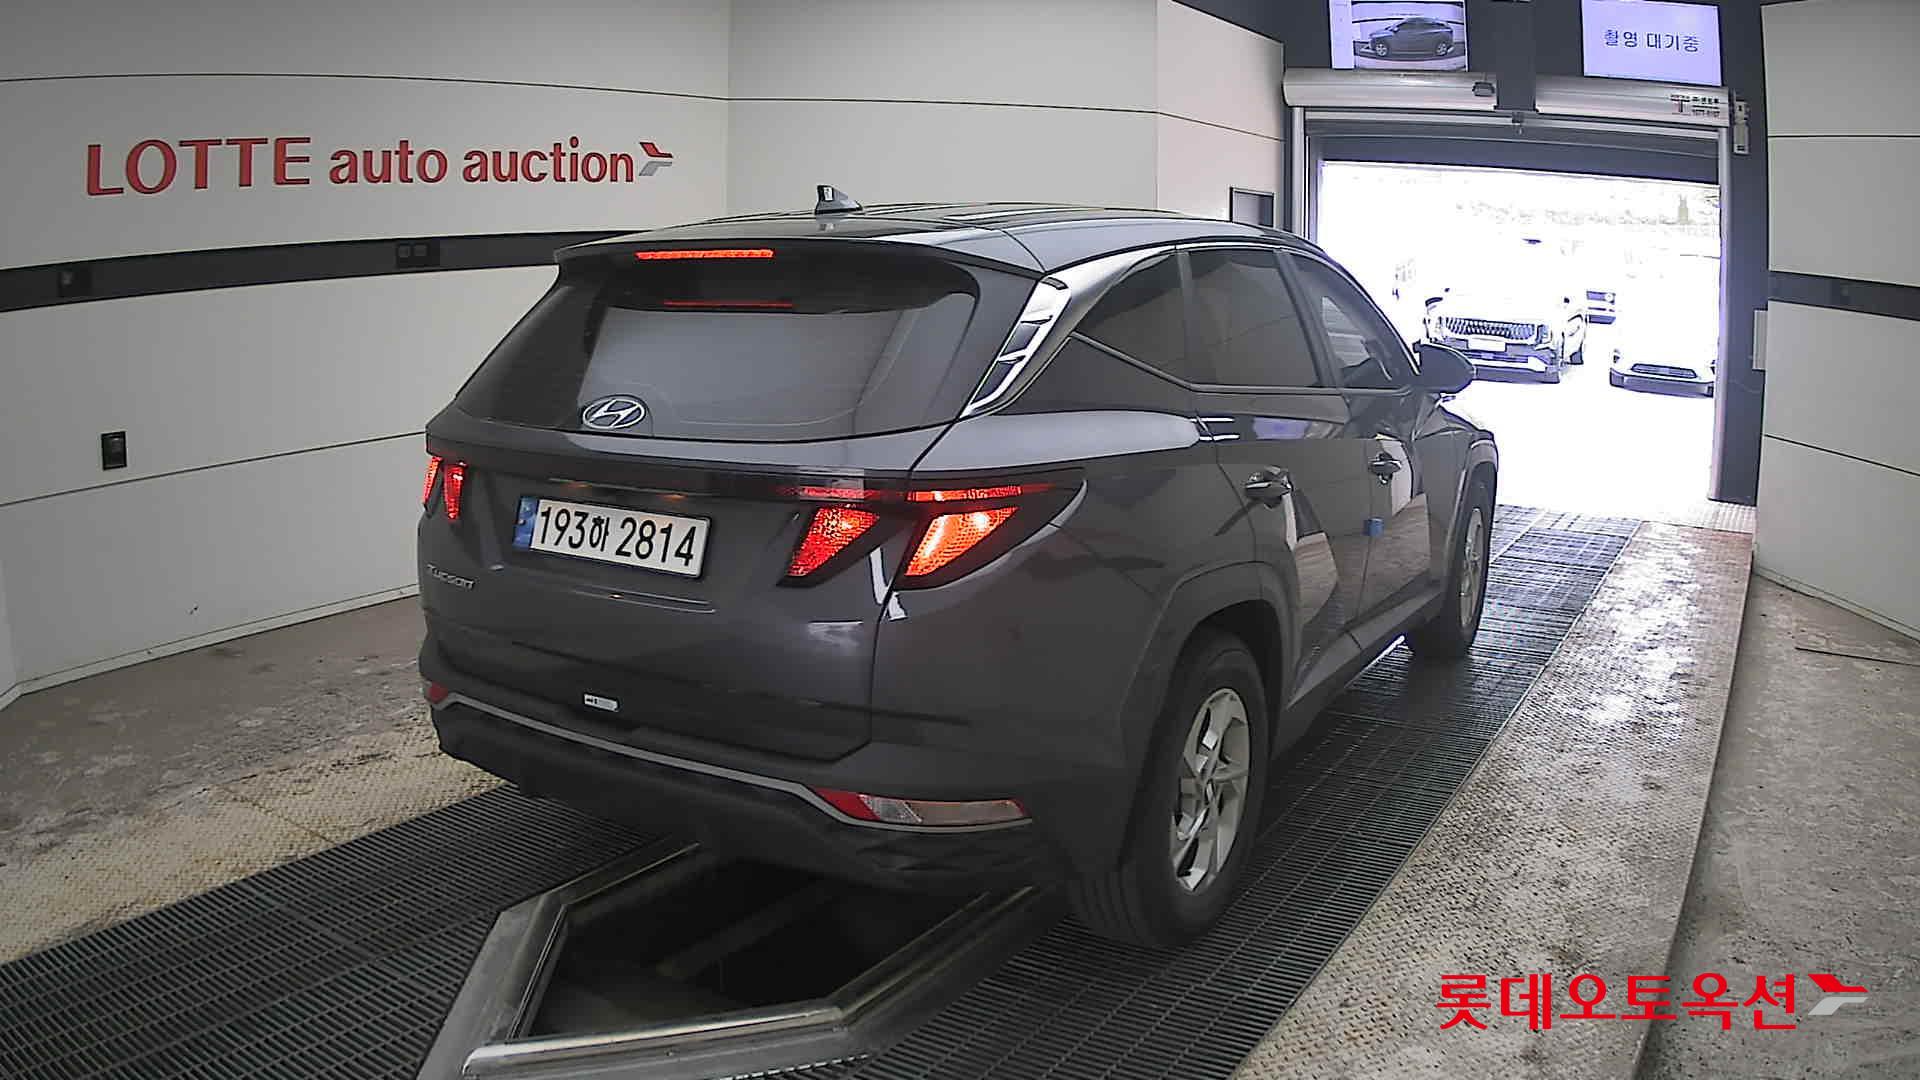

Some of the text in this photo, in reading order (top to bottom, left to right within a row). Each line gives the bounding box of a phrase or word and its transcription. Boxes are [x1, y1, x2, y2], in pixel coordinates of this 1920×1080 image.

[1604, 29, 1700, 53] 촬영 대기중
[87, 136, 635, 197] LOTTE auto auction
[540, 506, 698, 567] 193하 2814
